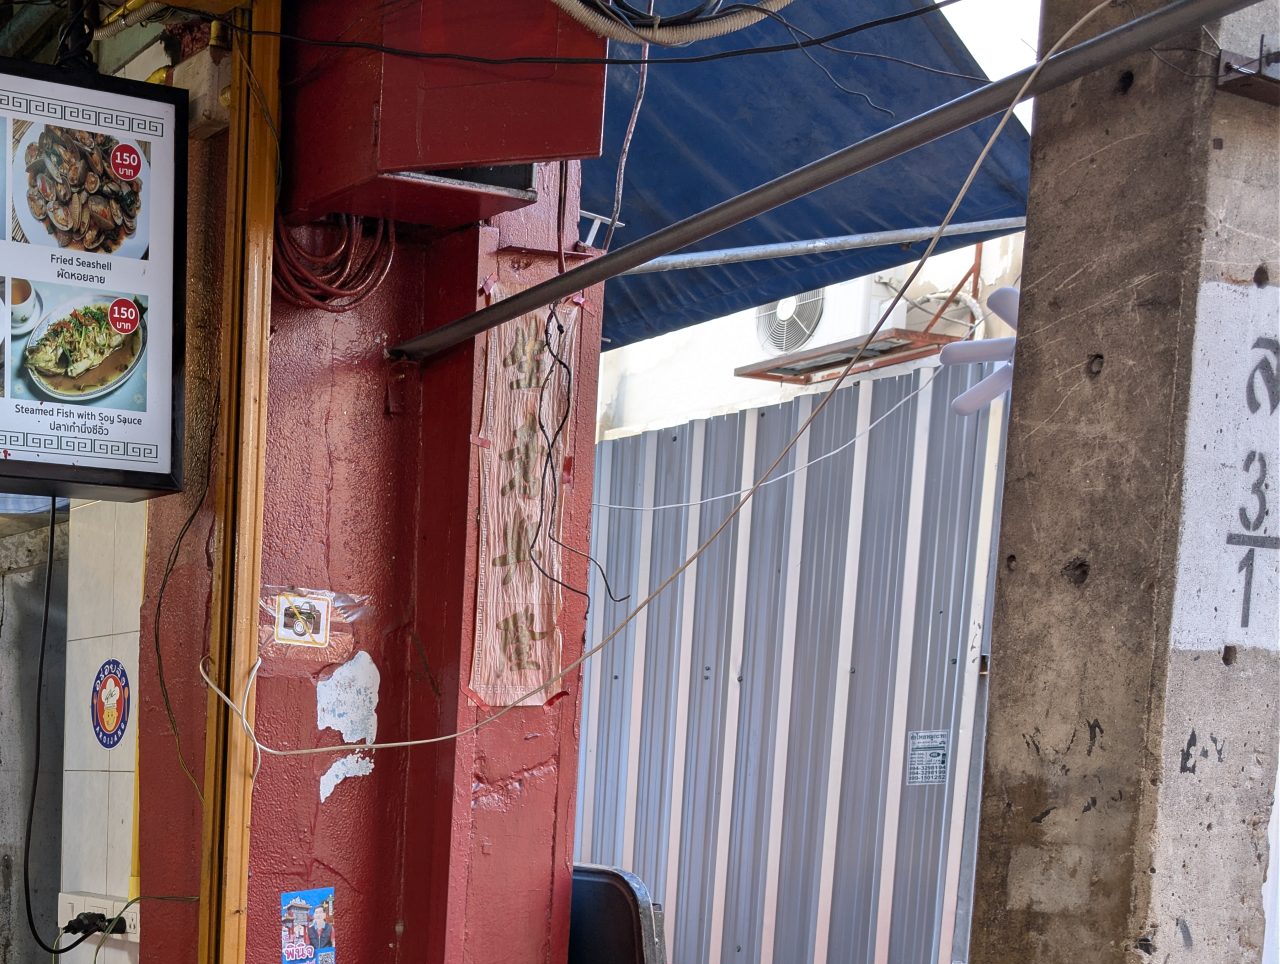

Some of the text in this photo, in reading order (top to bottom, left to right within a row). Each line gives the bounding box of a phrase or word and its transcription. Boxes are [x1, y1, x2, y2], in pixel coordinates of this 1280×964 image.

[115, 151, 138, 166] 150
[118, 168, 134, 177] บาท
[50, 253, 112, 271] Fried Seashell
[56, 268, 106, 284] ผัดหอยลาย
[112, 306, 136, 320] 150
[116, 322, 131, 330] บาท
[15, 404, 143, 426] Steamed Fish with Soy Sauce
